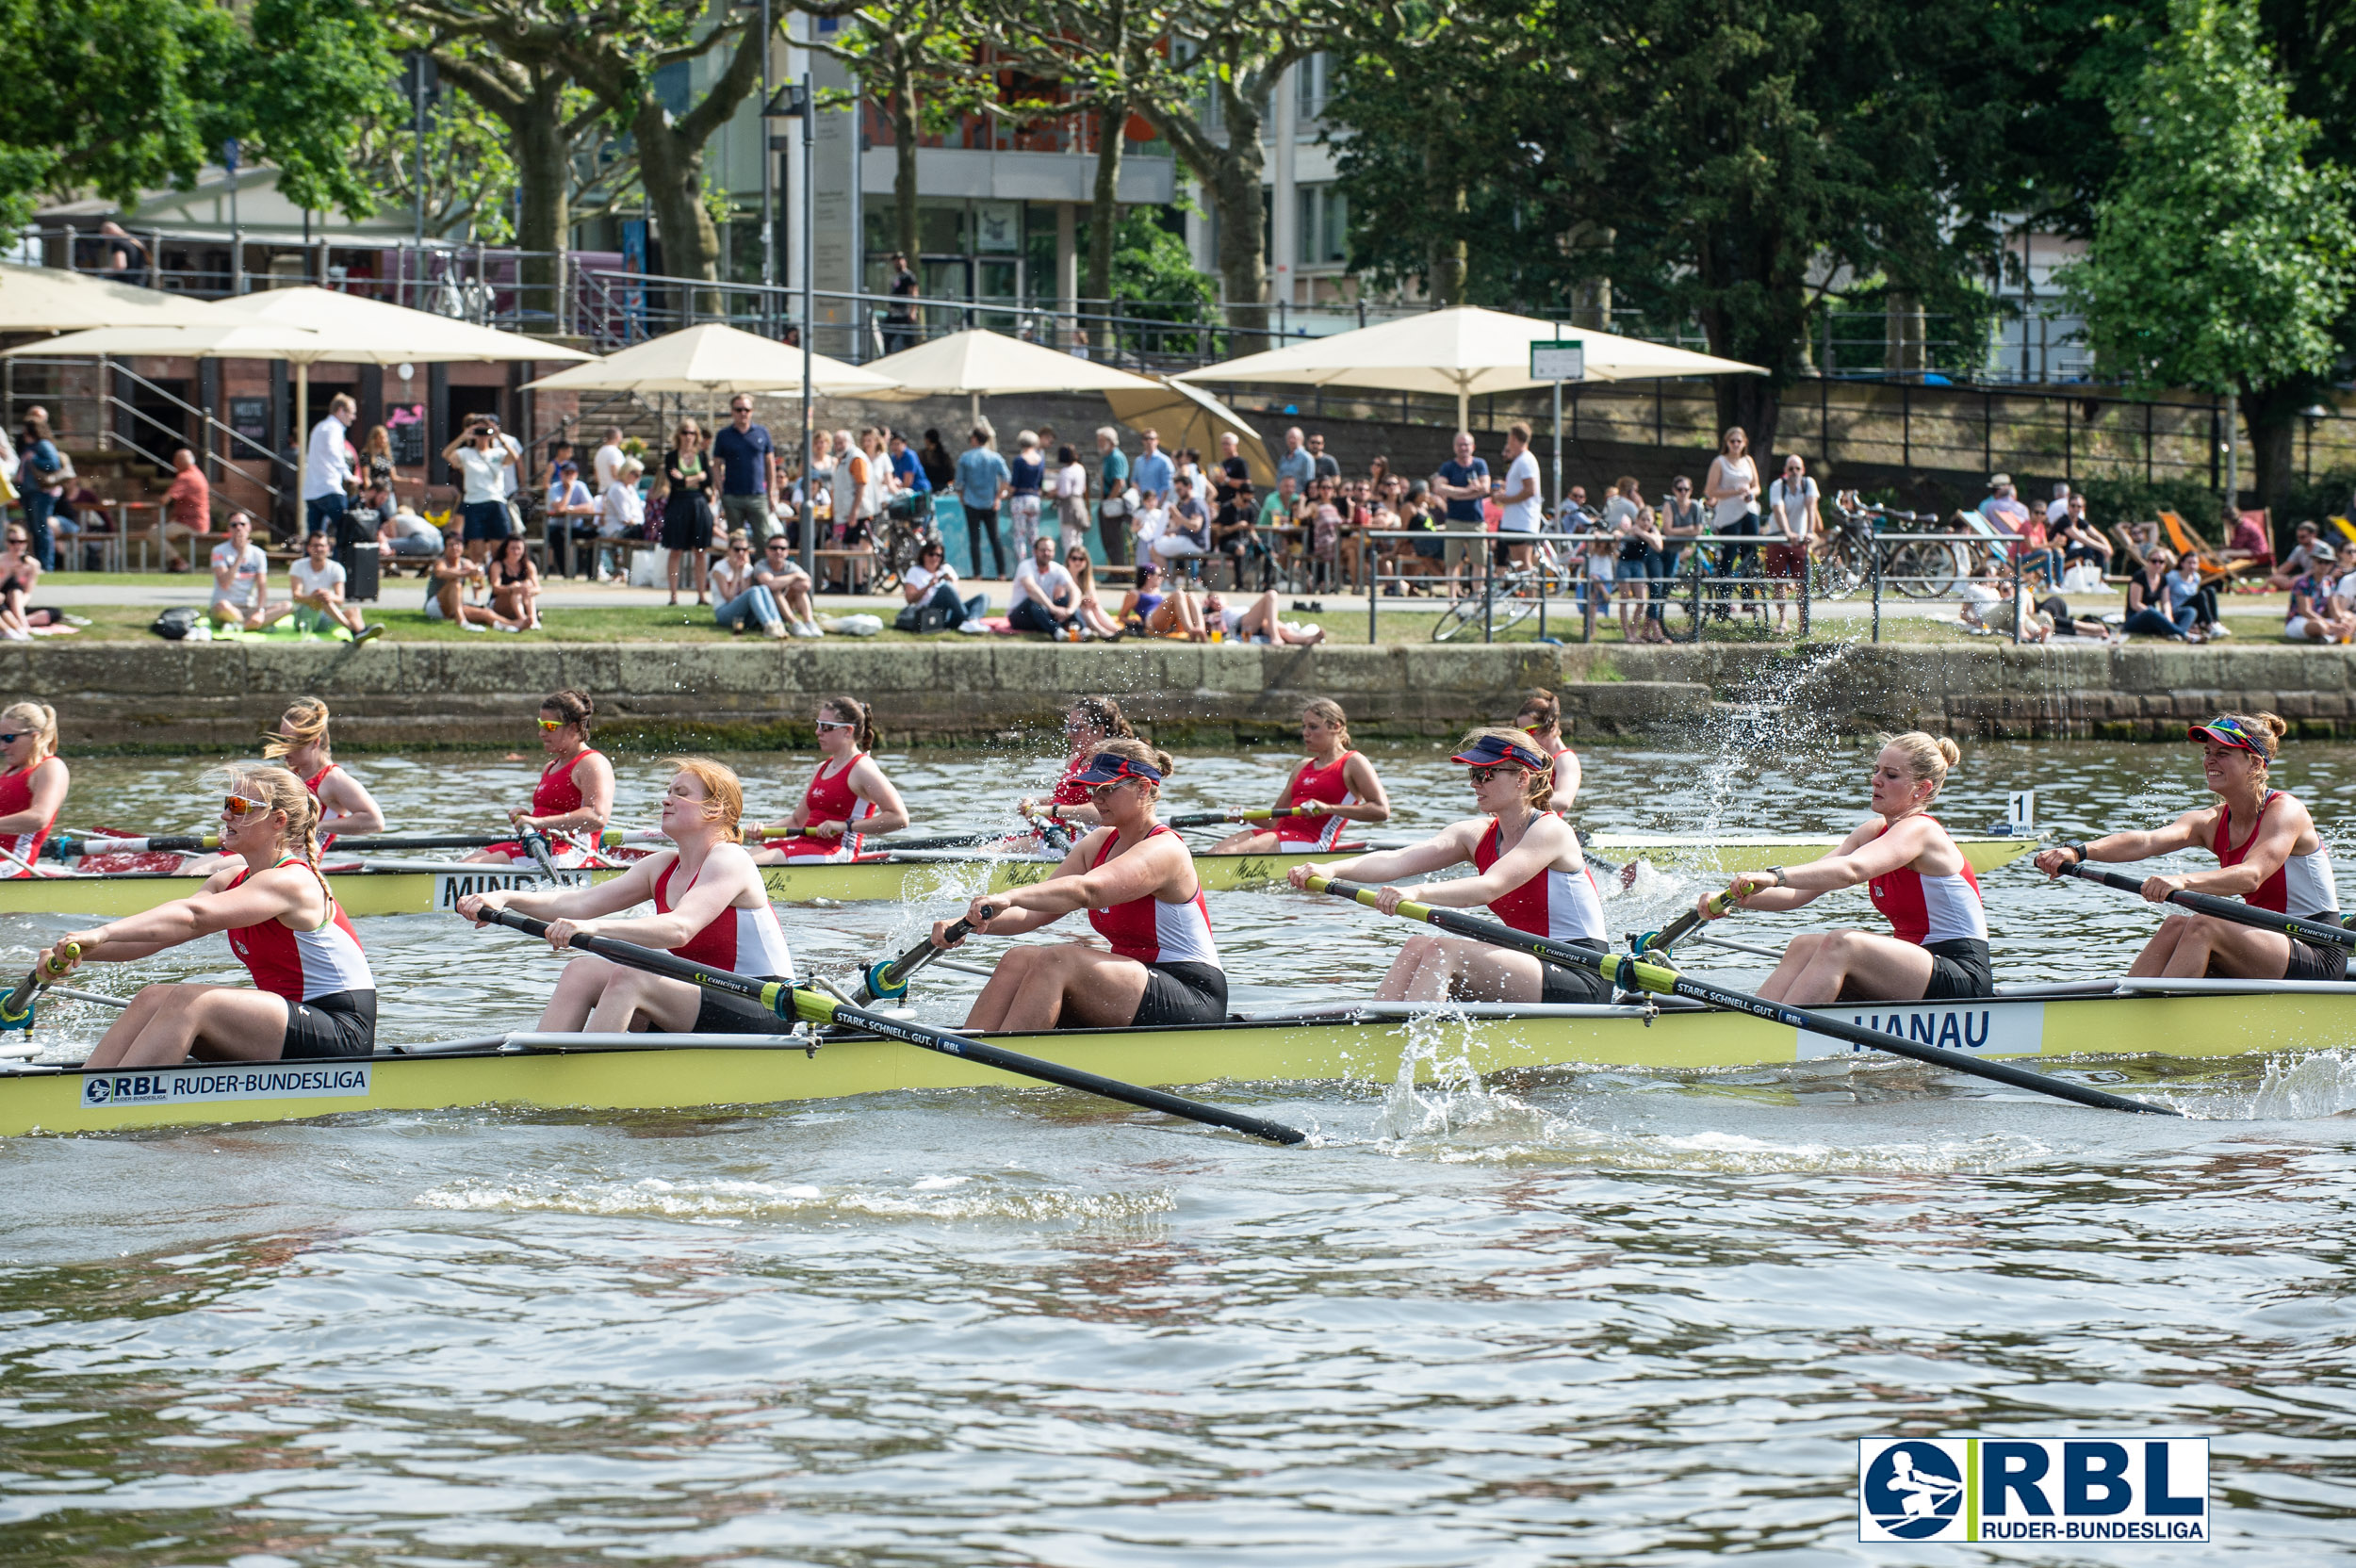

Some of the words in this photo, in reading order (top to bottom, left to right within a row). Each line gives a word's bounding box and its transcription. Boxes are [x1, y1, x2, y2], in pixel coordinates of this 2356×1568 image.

[2013, 794, 2023, 822] 1
[1230, 857, 1268, 879] Melitta
[2299, 927, 2333, 941] concept
[1546, 948, 1580, 961] concept
[708, 976, 741, 990] concept
[1677, 983, 1709, 999] STARK.
[1710, 991, 1752, 1011] SCHNELL.
[1753, 1004, 1775, 1018] GUT.
[1785, 1013, 1802, 1025] RBL
[837, 1012, 867, 1028] STARK.
[868, 1021, 910, 1040] SCHNELL.
[911, 1033, 932, 1047] GUT.
[943, 1040, 960, 1053] RBL
[114, 1076, 167, 1096] RBL
[173, 1070, 366, 1095] RUDER-BUNDESLIGA
